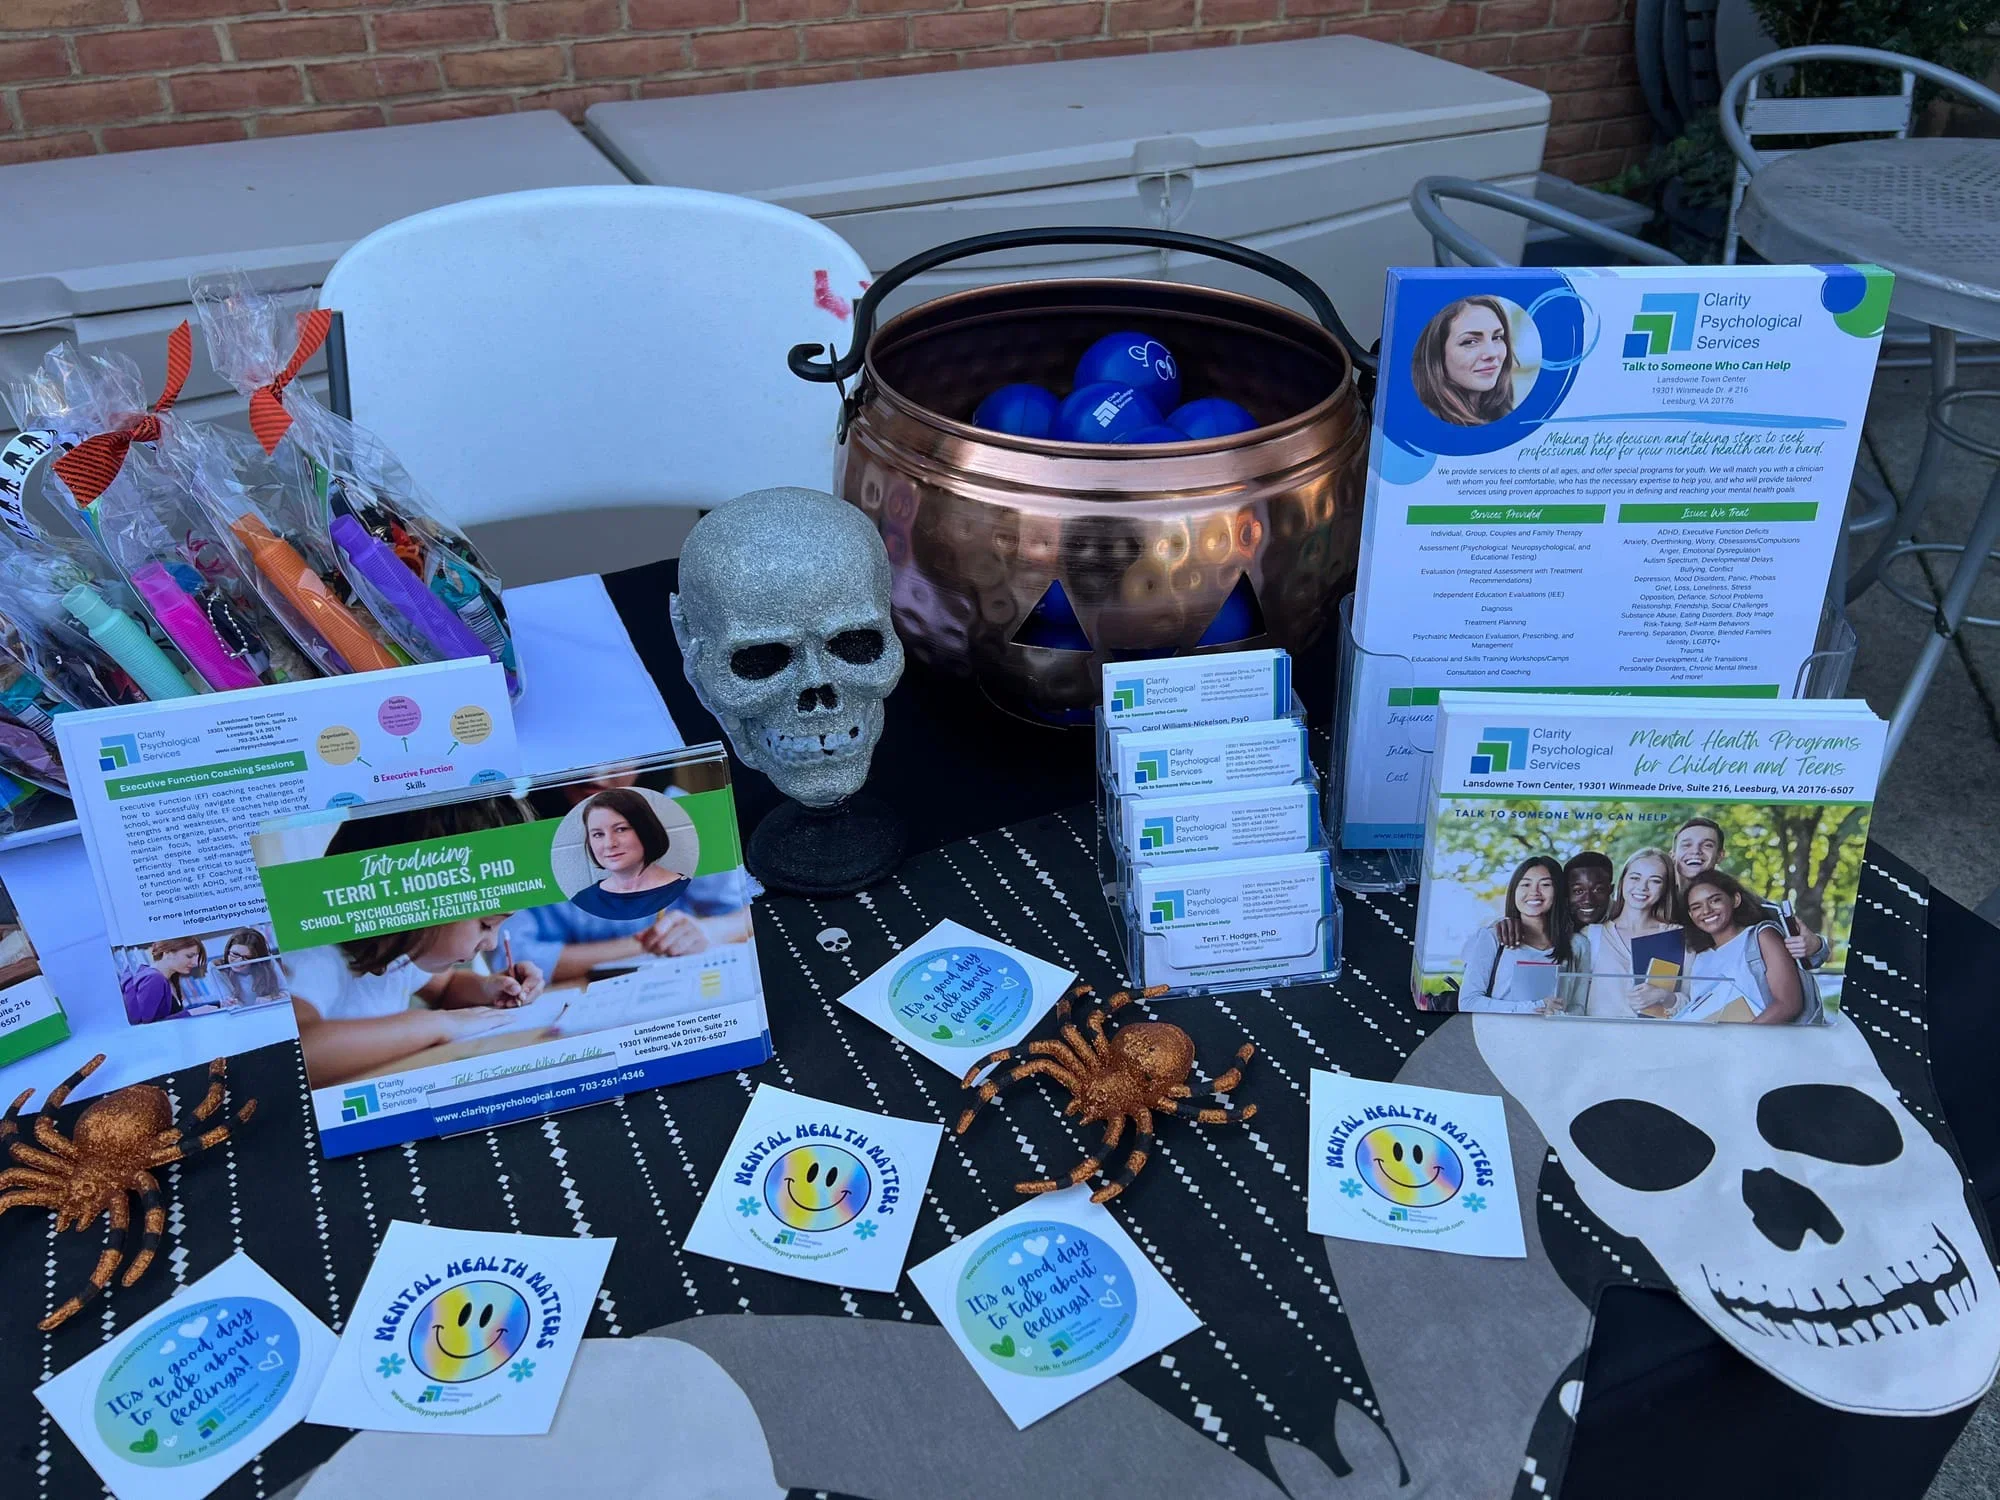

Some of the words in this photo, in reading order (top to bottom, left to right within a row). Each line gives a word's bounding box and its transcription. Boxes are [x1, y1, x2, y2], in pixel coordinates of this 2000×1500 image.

[1704, 292, 1751, 310] Clarity
[1700, 314, 1802, 332] Psychological
[1696, 336, 1760, 350] Services
[1622, 362, 1646, 371] Talk
[1648, 362, 1659, 371] to
[1660, 362, 1712, 371] Someone
[1715, 361, 1740, 370] Who
[1742, 361, 1763, 370] Can
[1765, 360, 1791, 372] Help
[1657, 376, 1699, 384] Lansdowne
[1722, 375, 1746, 383] Center
[1652, 386, 1674, 394] 19301
[1676, 386, 1714, 394] Winmeade
[1734, 386, 1749, 394] 216
[1470, 508, 1502, 520] Services
[1506, 508, 1543, 520] Provided
[1680, 508, 1708, 519] Issues
[1710, 507, 1726, 518] We
[1727, 506, 1750, 518] Treat
[1481, 605, 1513, 613] Diagnosis
[1498, 619, 1527, 627] Planning
[1500, 669, 1531, 677] Coaching
[1146, 676, 1170, 687] Clarity
[1146, 684, 1196, 696] Psychological
[1146, 695, 1178, 705] Services
[1142, 723, 1161, 732] Carol
[1231, 715, 1250, 725] PsyD
[137, 729, 166, 741] Clarity
[1533, 728, 1572, 741] Clarity
[1629, 728, 1694, 749] Mental
[1701, 731, 1760, 752] Health
[1769, 730, 1862, 753] Programs
[140, 736, 200, 753] Psychological
[1532, 744, 1614, 758] Psychological
[143, 750, 181, 761] Services
[1170, 748, 1195, 758] Clarity
[1170, 755, 1222, 767] Psychological
[1529, 758, 1580, 770] Services
[1634, 754, 1664, 776] for
[1668, 754, 1749, 775] Children
[1753, 760, 1787, 776] and
[1795, 756, 1847, 776] Teens
[119, 779, 166, 792] Executive
[167, 773, 210, 785] Function
[211, 765, 254, 779] Coaching
[255, 760, 296, 772] Sessions
[373, 775, 380, 783] 8
[381, 769, 418, 782] Executive
[419, 764, 454, 776] Function
[1170, 766, 1204, 777] Services
[405, 780, 426, 791] Skills
[1463, 779, 1514, 788] Lansdowne
[1516, 780, 1541, 789] Town
[1543, 781, 1575, 791] Center,
[1579, 782, 1606, 790] 19301
[1609, 782, 1656, 791] Winmeade
[1658, 783, 1684, 793] Drive,
[1686, 784, 1710, 792] Suite
[1712, 784, 1732, 794] 216,
[1734, 784, 1778, 796] Leesburg,
[1782, 785, 1795, 793] VA
[1797, 785, 1854, 795] 20176-6507
[1175, 814, 1200, 824] Clarity
[1455, 809, 1486, 819] TALK
[1490, 810, 1505, 820] TO
[1509, 810, 1569, 821] SOMEONE
[1572, 810, 1603, 821] WHO
[1608, 811, 1633, 821] CAN
[1638, 811, 1668, 822] HELP
[1176, 821, 1228, 833] Psychological
[1176, 832, 1210, 843] Services
[360, 845, 473, 880] Introducing
[322, 885, 376, 907] TERRI
[379, 880, 399, 897] T.
[402, 867, 476, 894] HODGES,
[480, 859, 515, 880] PHD
[1186, 887, 1212, 897] Clarity
[300, 916, 345, 931] SCHOOL
[346, 899, 428, 923] PSYCHOLOGIST,
[431, 891, 478, 907] TESTING
[479, 878, 546, 900] TECHNICIAN,
[1187, 895, 1240, 908] Psychological
[354, 921, 378, 934] AND
[378, 911, 431, 929] PROGRAM
[432, 899, 501, 920] FACILITATOR
[1187, 906, 1221, 917] Services
[1202, 935, 1220, 943] Terri
[1229, 931, 1260, 942] Hodges,
[1261, 929, 1277, 938] PhD
[900, 1001, 925, 1019] It's
[924, 993, 935, 1002] a
[933, 970, 961, 996] good
[956, 952, 981, 972] day
[921, 1013, 938, 1024] to
[934, 991, 961, 1013] talk
[960, 962, 991, 993] about
[14, 1000, 31, 1010] 216
[950, 980, 998, 1024] feelings!
[634, 1022, 675, 1036] Lansdowne
[677, 1019, 697, 1028] Town
[698, 1013, 722, 1023] Center
[619, 1038, 641, 1049] 19301
[643, 1031, 681, 1044] Winmeade
[682, 1027, 703, 1036] Drive,
[704, 1022, 723, 1032] Suite
[724, 1018, 738, 1028] 216
[634, 1043, 671, 1056] Leesburg,
[672, 1040, 683, 1049] VA
[684, 1031, 727, 1046] 20176-6507
[378, 1078, 404, 1090] Clarity
[379, 1082, 437, 1101] Psychological
[435, 1086, 576, 1124] www.claritypsychological.com
[579, 1068, 645, 1092] 703-261-4346
[382, 1096, 418, 1110] Services
[1325, 1114, 1365, 1169] MENTAL
[1363, 1105, 1438, 1126] HEALTH
[1440, 1121, 1494, 1188] MATTERS
[733, 1131, 792, 1186] MENTAL
[795, 1123, 869, 1149] HEALTH
[866, 1145, 900, 1216] MATTERS
[966, 1293, 998, 1316] It's
[1001, 1285, 1015, 1297] a
[1017, 1256, 1057, 1290] good
[1056, 1239, 1090, 1264] day
[987, 1312, 1008, 1331] to
[1007, 1287, 1047, 1318] talk
[1049, 1258, 1098, 1295] about
[373, 1273, 442, 1342] MENTAL
[446, 1256, 529, 1279] HEALTH
[525, 1271, 561, 1349] MATTERS
[1022, 1284, 1095, 1340] feelings!
[105, 1388, 144, 1418] It's
[149, 1375, 165, 1389] a
[168, 1336, 214, 1377] good
[216, 1307, 254, 1339] day
[129, 1407, 154, 1427] to
[153, 1374, 201, 1409] talk
[203, 1323, 261, 1374] about
[169, 1355, 254, 1427] feelings!
